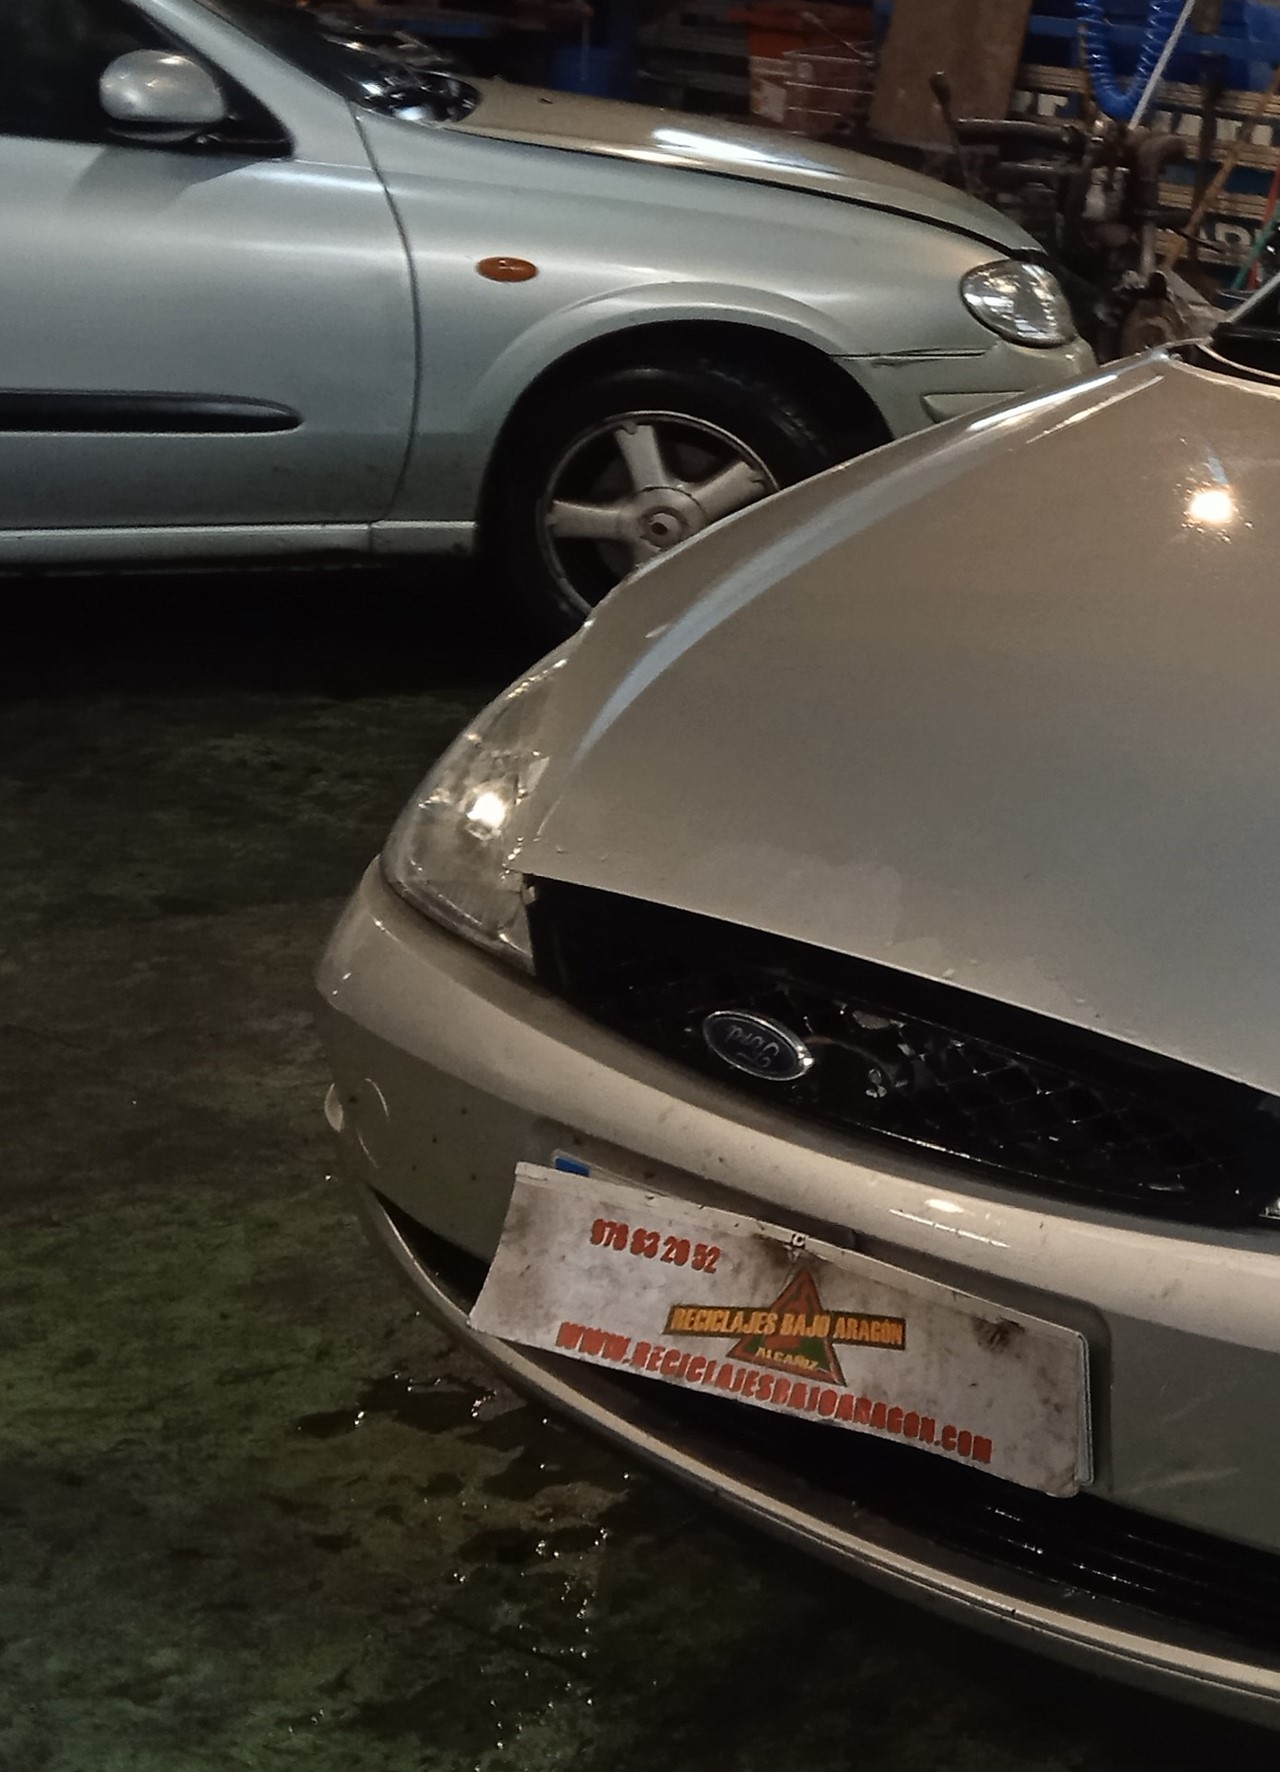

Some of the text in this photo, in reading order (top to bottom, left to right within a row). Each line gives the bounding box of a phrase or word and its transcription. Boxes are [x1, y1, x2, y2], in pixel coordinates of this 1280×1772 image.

[660, 1235, 691, 1266] 20
[670, 1307, 779, 1335] RECICLAJES
[779, 1313, 831, 1338] BAJO
